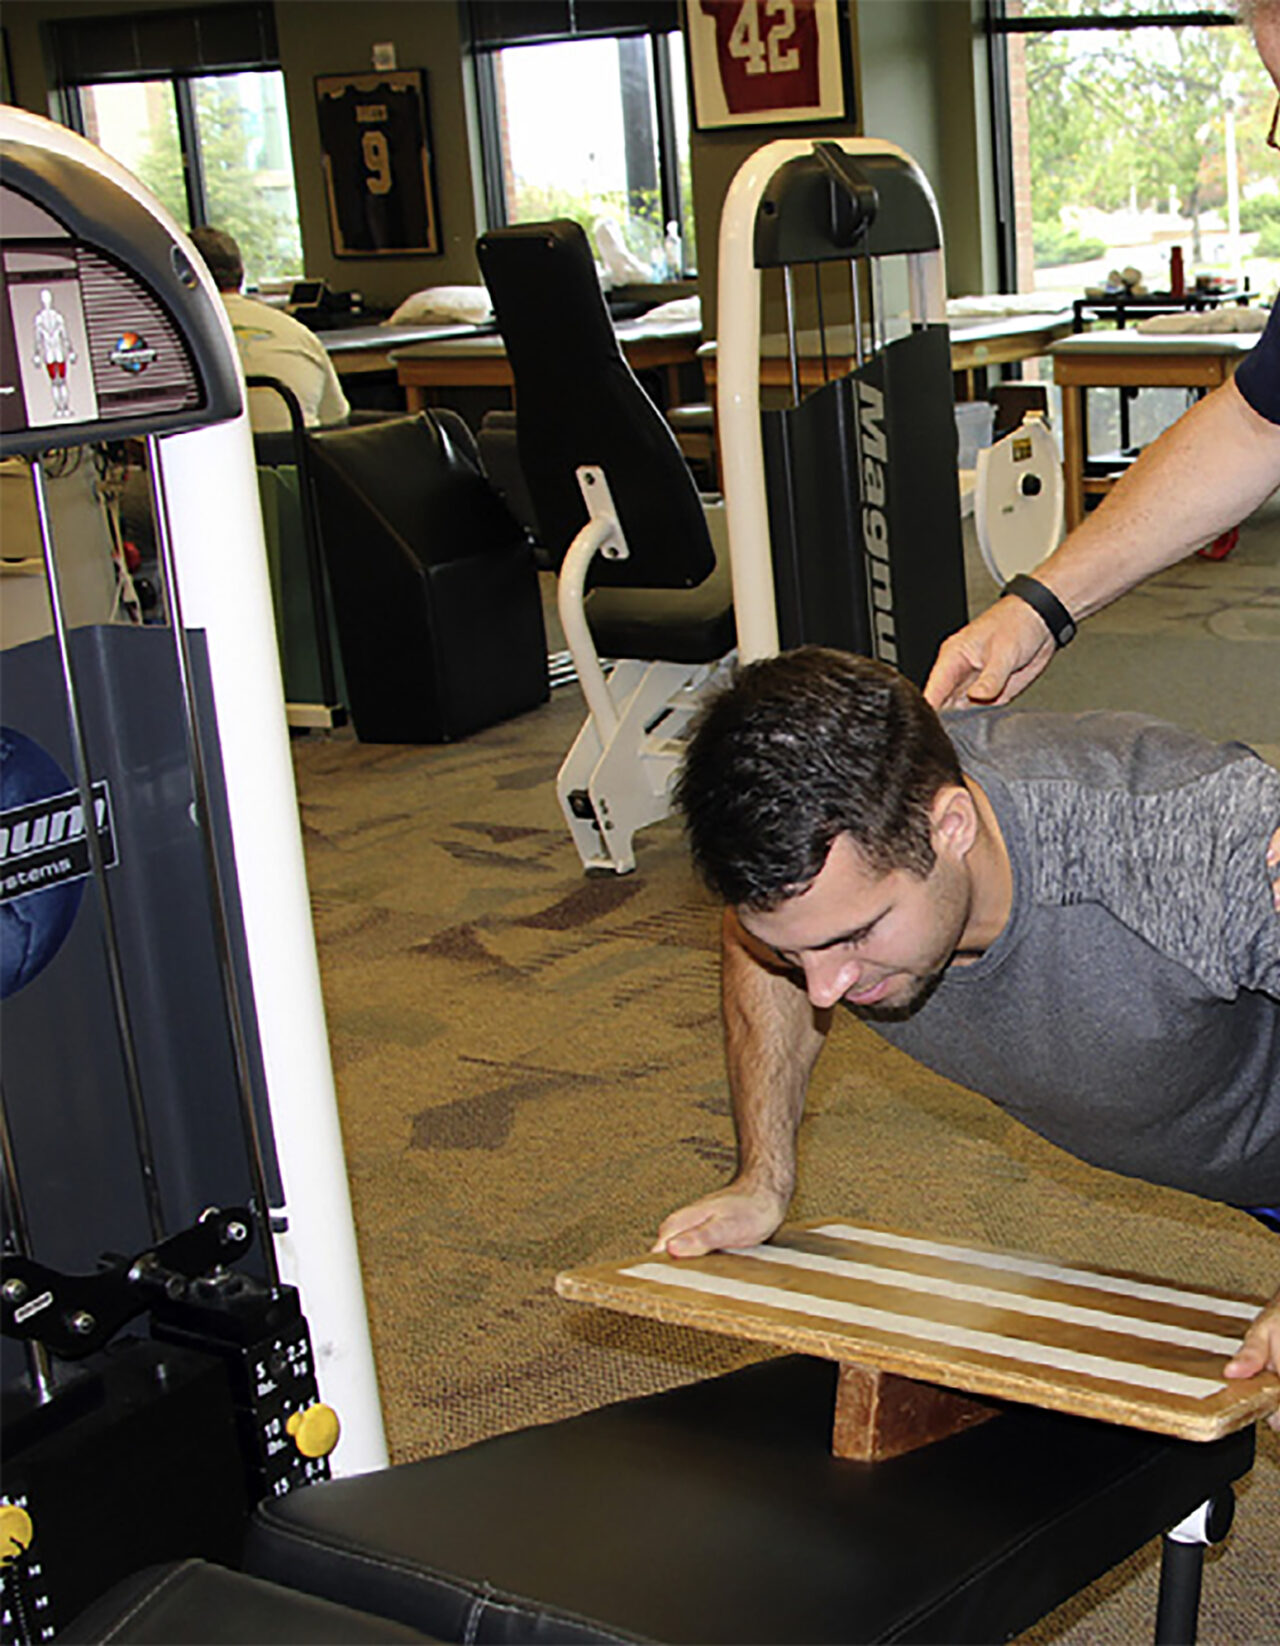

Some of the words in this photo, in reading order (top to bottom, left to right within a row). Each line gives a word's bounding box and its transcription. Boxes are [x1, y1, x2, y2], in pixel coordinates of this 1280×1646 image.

[728, 0, 800, 76] 42
[361, 130, 392, 195] 9
[857, 379, 898, 671] Magnu
[0, 857, 72, 896] stems
